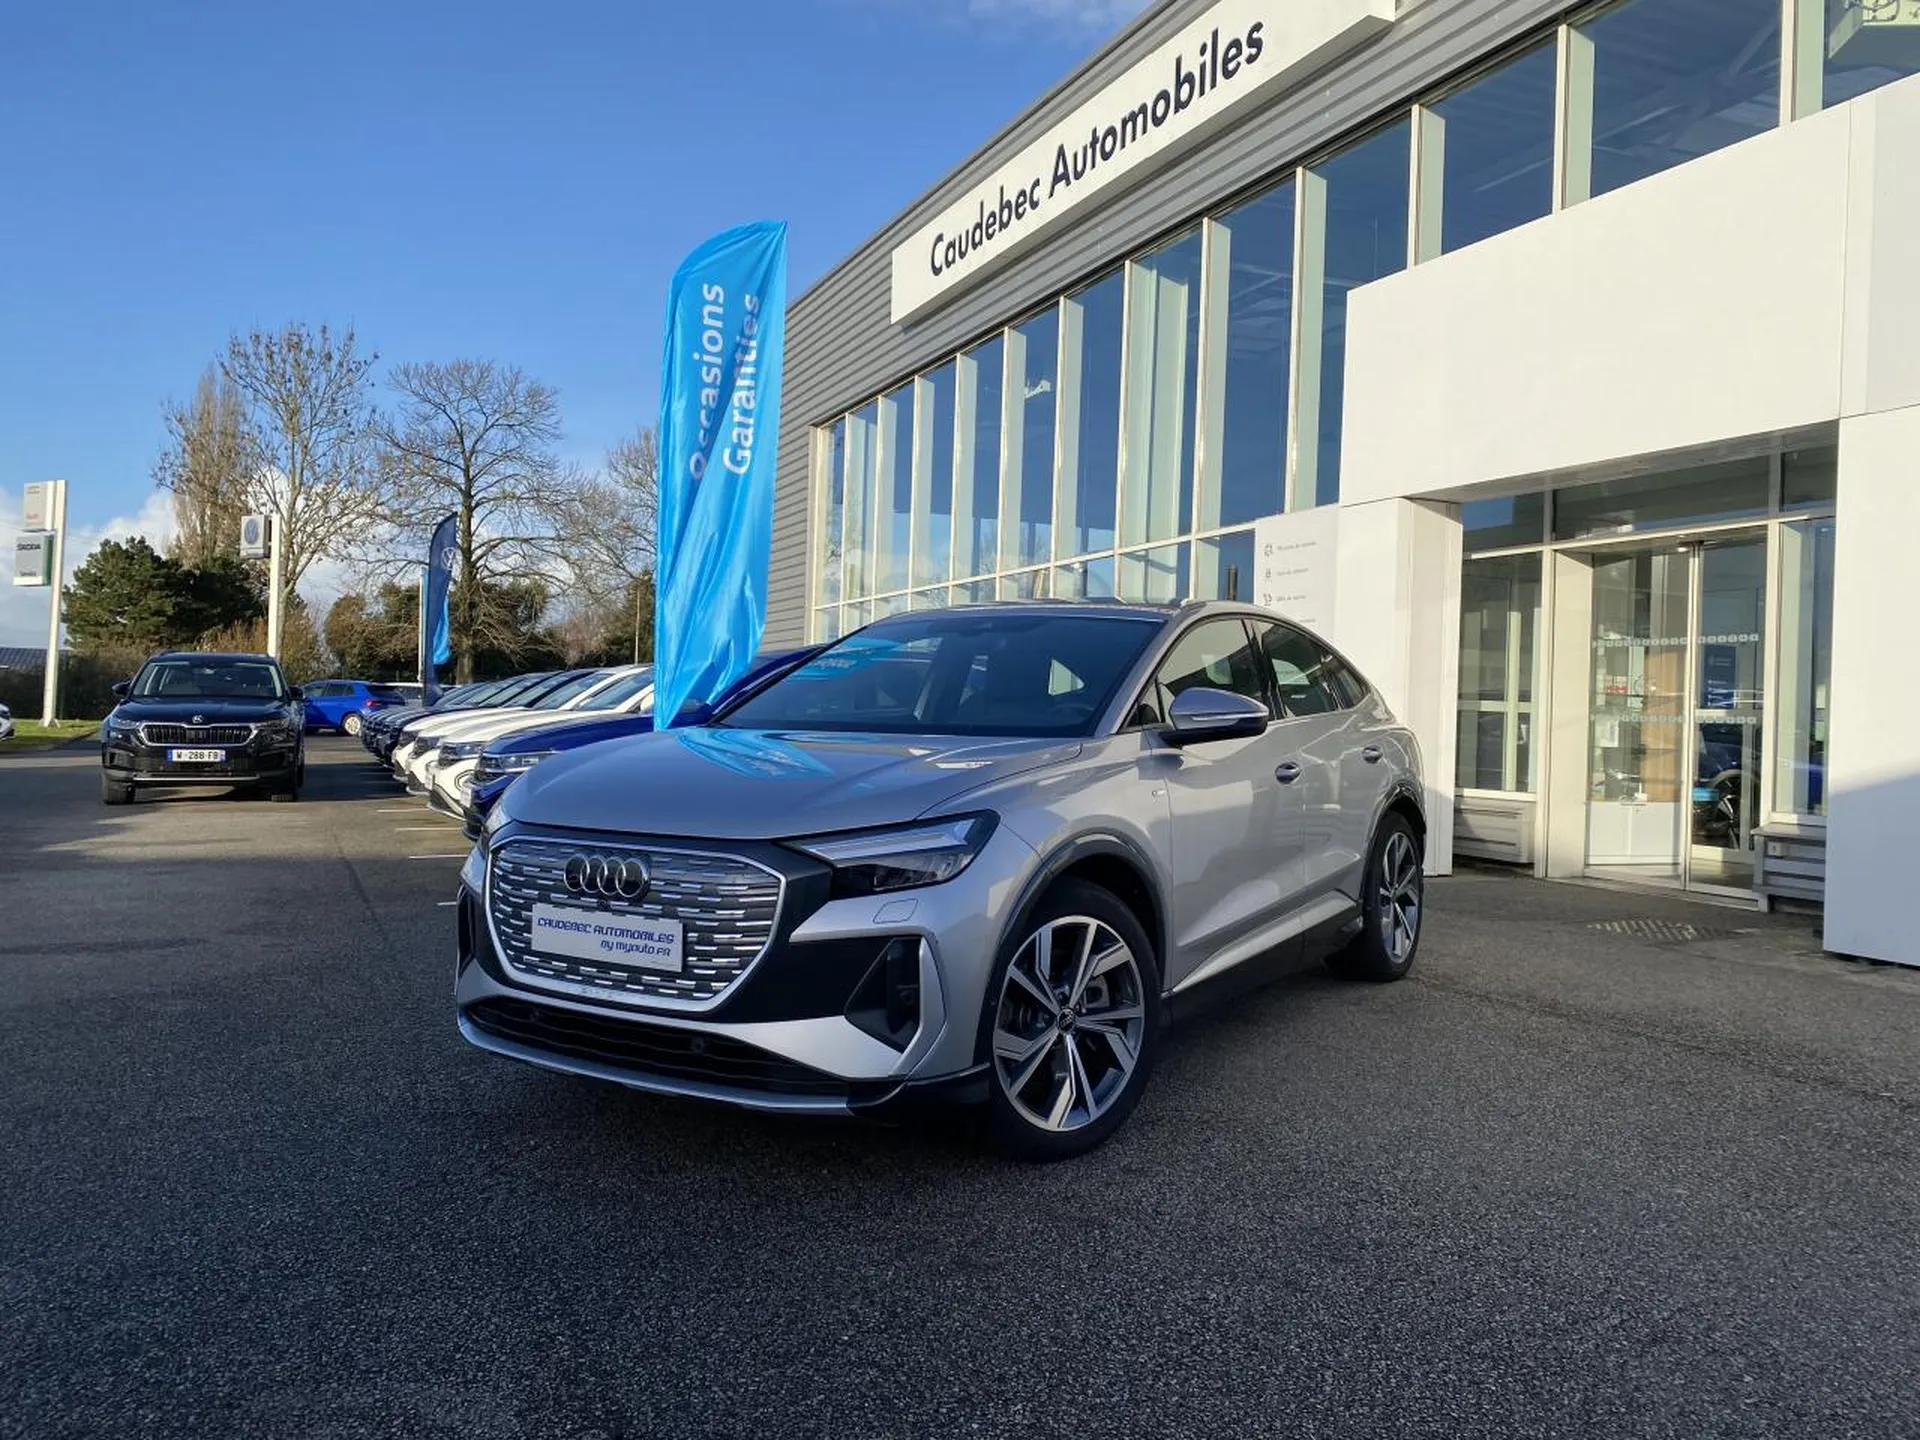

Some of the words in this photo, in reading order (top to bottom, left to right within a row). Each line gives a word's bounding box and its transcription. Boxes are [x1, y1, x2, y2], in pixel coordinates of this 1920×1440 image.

[929, 174, 1041, 277] Caudebec
[1048, 20, 1265, 200] Automobiles
[689, 283, 725, 481] Occasions
[722, 293, 760, 475] Garanties
[537, 917, 592, 934] CAUDEBEC
[593, 922, 675, 944] AUTOMOBILES
